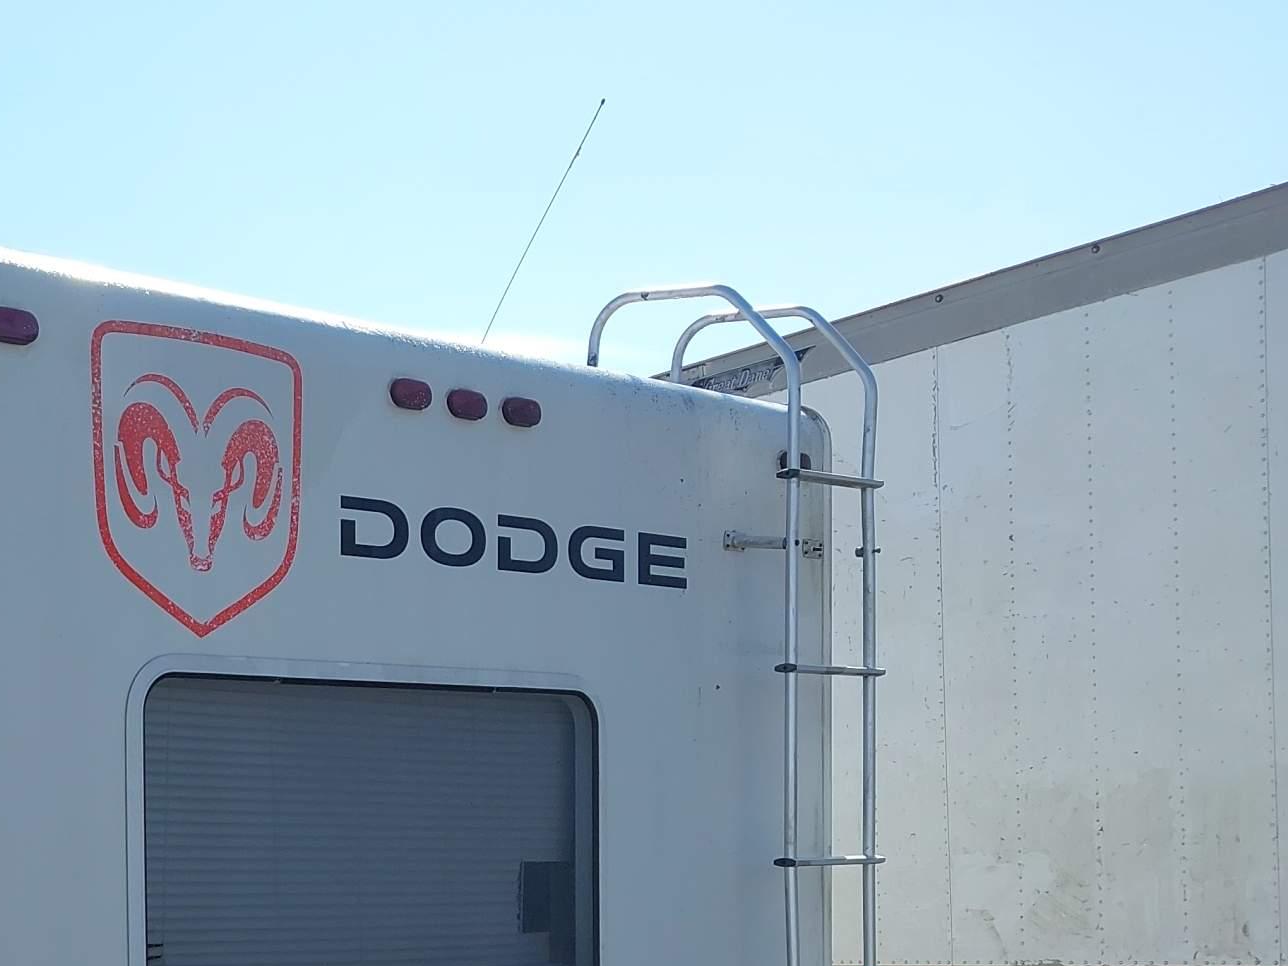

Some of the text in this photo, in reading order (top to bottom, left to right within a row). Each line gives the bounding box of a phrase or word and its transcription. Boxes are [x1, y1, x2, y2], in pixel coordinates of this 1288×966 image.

[704, 368, 770, 391] Great Dane
[340, 495, 688, 589] DODGE
